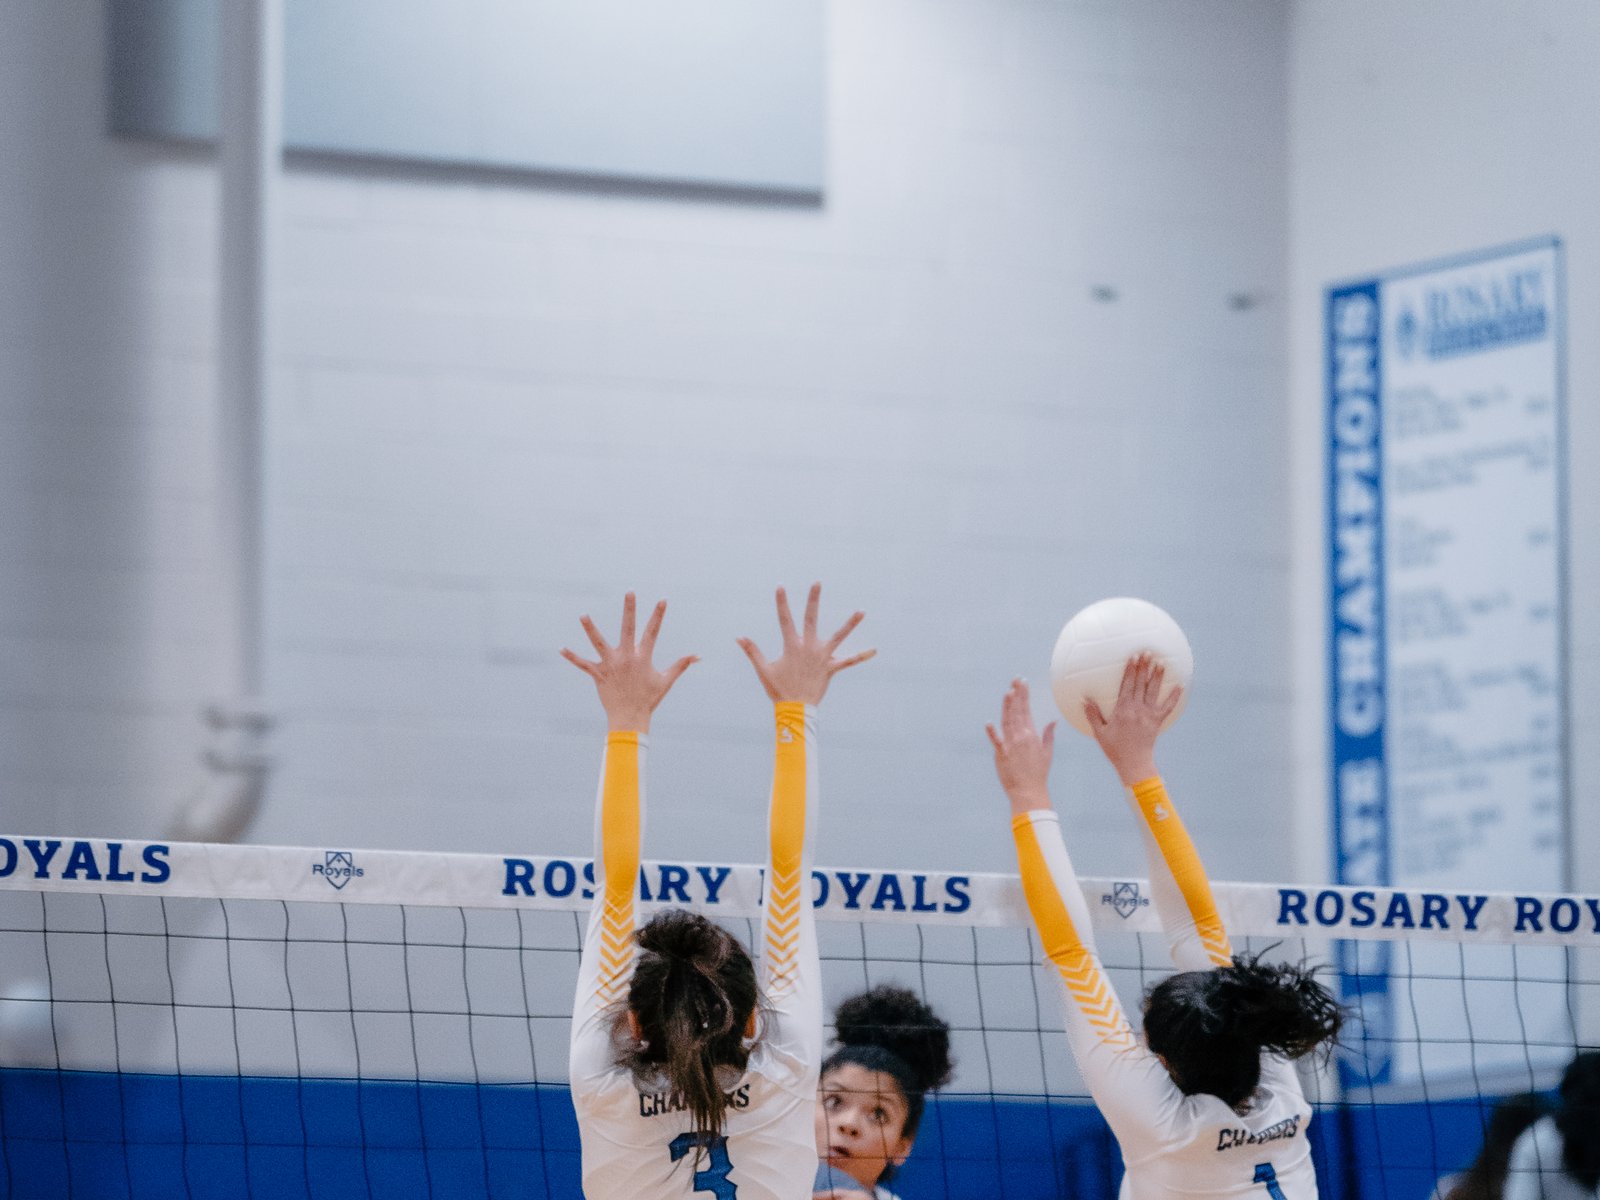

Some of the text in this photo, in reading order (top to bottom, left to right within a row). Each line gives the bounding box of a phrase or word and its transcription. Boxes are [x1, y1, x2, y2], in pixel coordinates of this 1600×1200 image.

[0, 838, 171, 884] OYALS
[312, 863, 364, 879] Royals
[758, 868, 971, 914] OYALS
[1277, 888, 1488, 931] ROSARY
